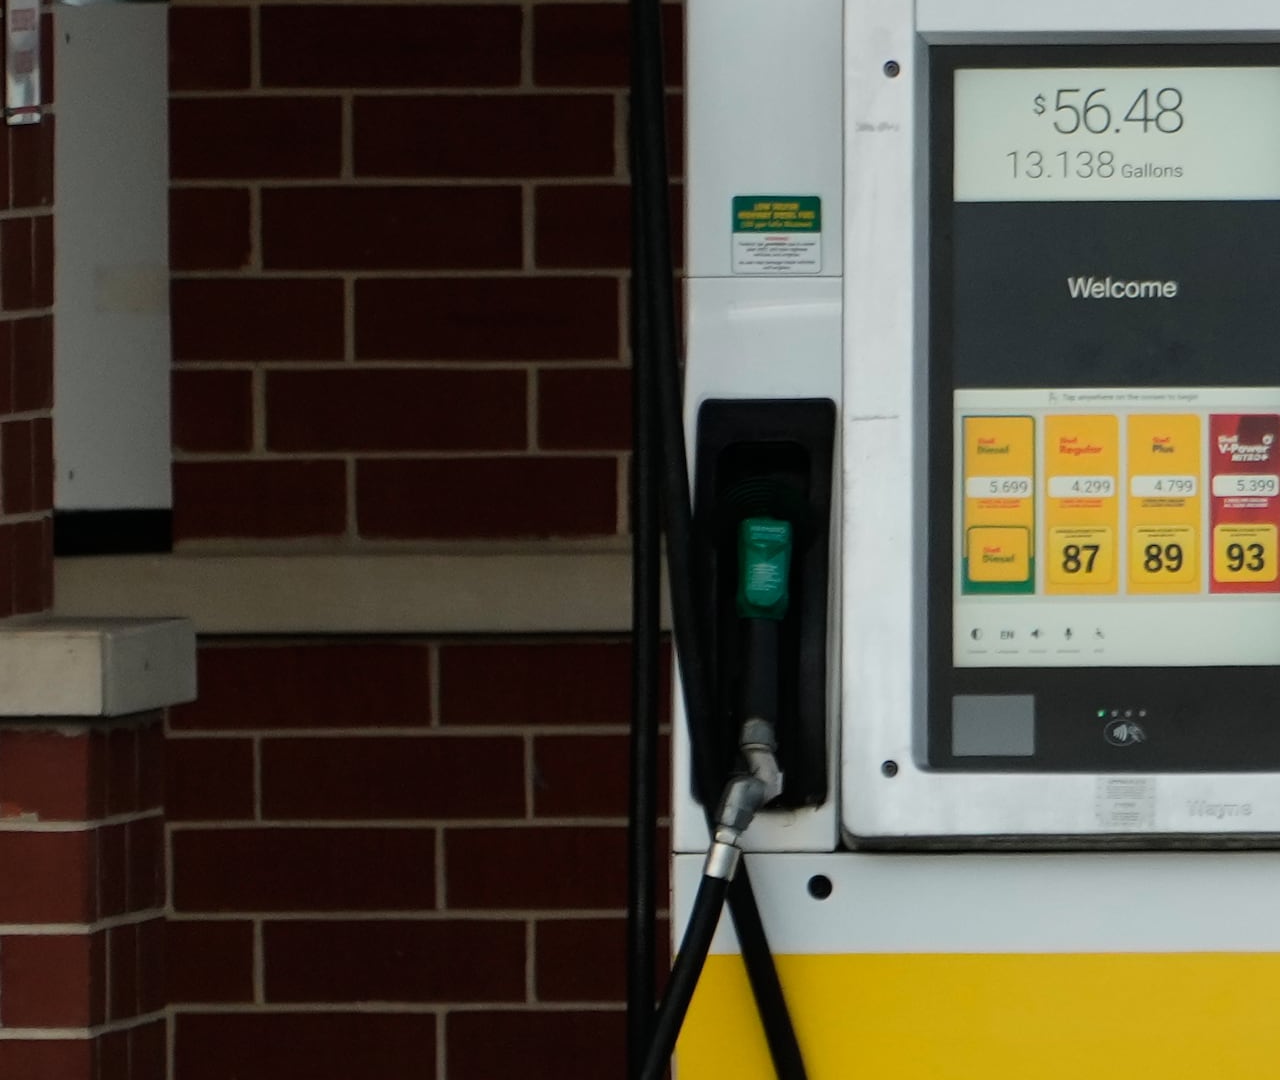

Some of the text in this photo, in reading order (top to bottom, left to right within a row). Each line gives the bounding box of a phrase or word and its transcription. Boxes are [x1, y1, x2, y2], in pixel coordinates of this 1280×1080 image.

[1006, 150, 1184, 182] 13.138 Gallons
[1067, 276, 1178, 300] Welcome
[1059, 445, 1102, 456] Regular
[1152, 445, 1174, 453] Plus
[989, 481, 1028, 494] 5.699
[1072, 480, 1111, 493] 4.299
[1154, 480, 1193, 492] 4.799
[1237, 480, 1275, 491] 5.399
[1062, 544, 1100, 574] 87
[1143, 543, 1183, 574] 89
[1226, 543, 1265, 573] 93
[1000, 631, 1015, 640] EN
